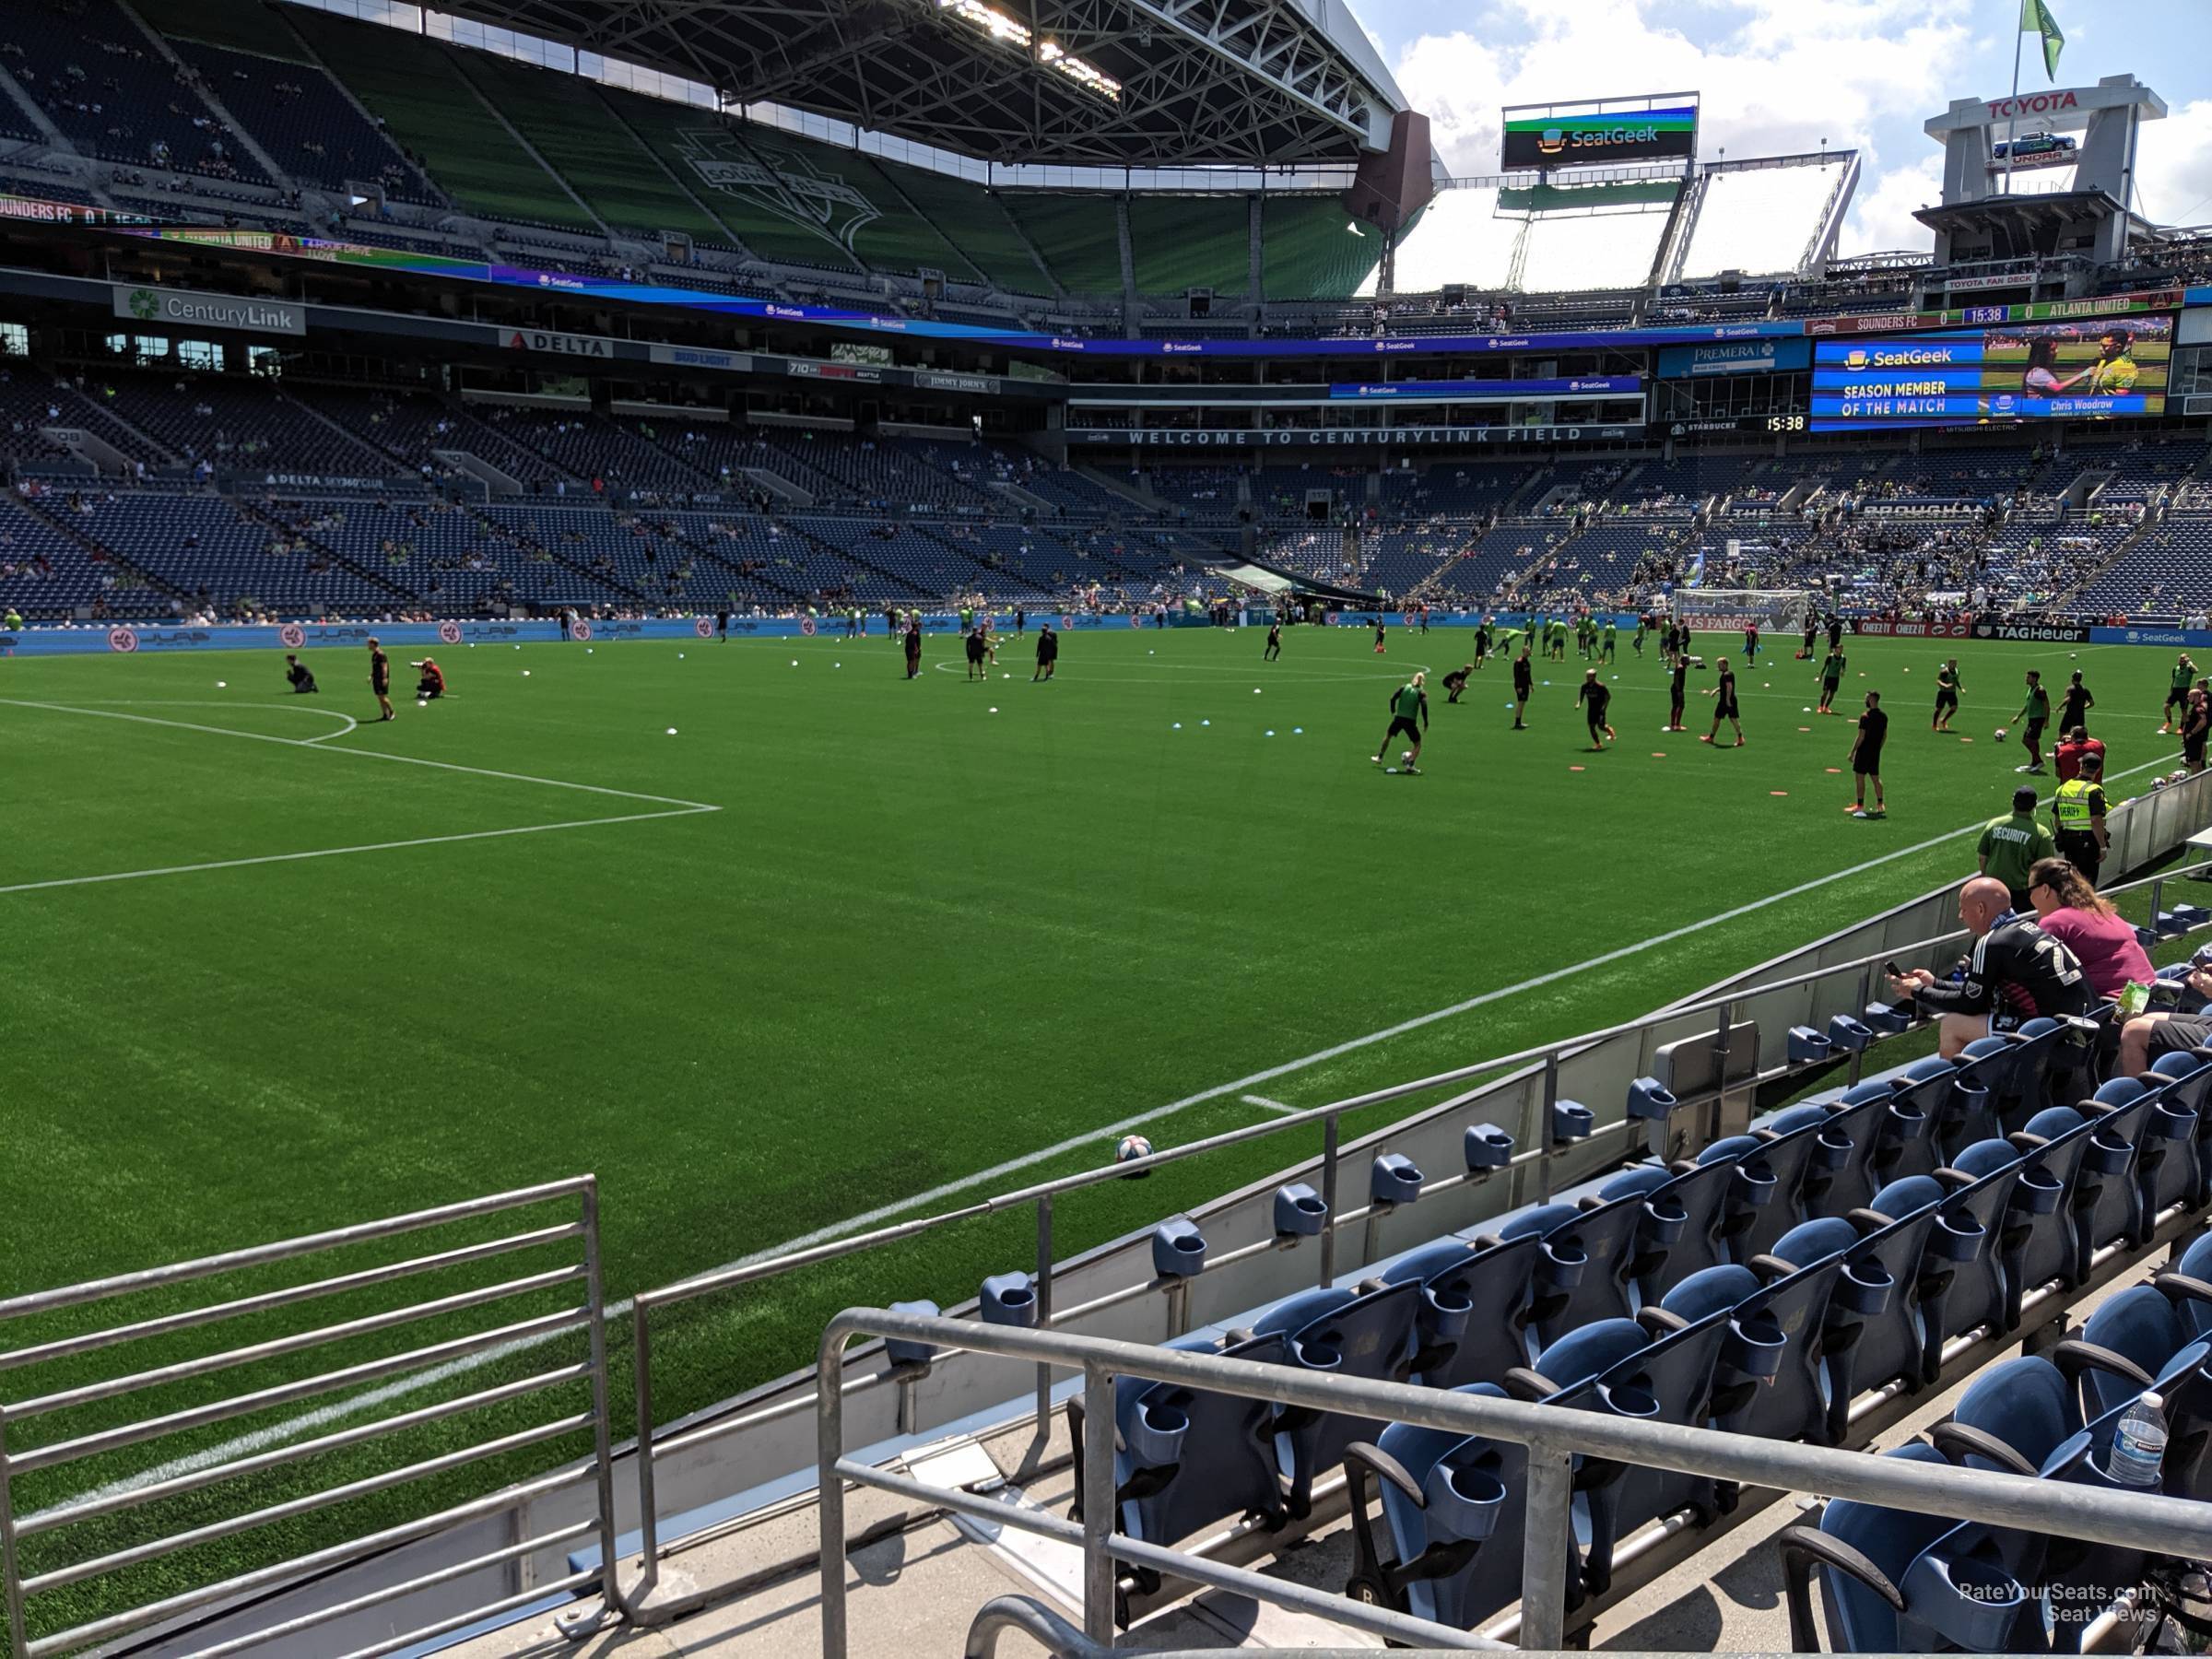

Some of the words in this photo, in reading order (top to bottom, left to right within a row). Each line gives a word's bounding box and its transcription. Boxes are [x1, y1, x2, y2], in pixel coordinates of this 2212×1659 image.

[1988, 91, 2077, 118] TOYOTA
[1571, 126, 1658, 147] SeatGeek
[2005, 152, 2062, 164] UNDRA
[57, 208, 72, 223] FC
[235, 235, 271, 250] UNITED
[1950, 279, 1983, 288] TOYOTA
[1987, 277, 2004, 286] FAN
[2007, 276, 2031, 284] DECK
[168, 298, 293, 328] CenturyLink
[1858, 316, 1904, 330] SOUNDERS
[1906, 315, 1917, 327] FC
[1940, 312, 1947, 324] 0
[1972, 308, 2001, 323] 15:38
[2025, 306, 2033, 318] 0
[2050, 301, 2092, 316] ATLANTA
[2095, 299, 2130, 312] UNITED
[1726, 327, 1758, 336] SeatGeek
[535, 335, 604, 355] DELTA
[1386, 342, 1415, 350] SeatGeek
[1499, 338, 1529, 347] SeatGeek
[1695, 347, 1755, 361] PREMERA
[1874, 347, 1951, 366] SeatGeek
[790, 363, 808, 373] 710
[930, 376, 958, 386] JIMMY
[1581, 381, 1610, 390] SeatGeek
[1844, 383, 1891, 399] SEASON
[1895, 381, 1946, 396] MEMBER
[1842, 403, 1859, 416] OF
[1866, 401, 1890, 415] THE
[1897, 398, 1945, 413] MATCH
[2051, 400, 2072, 411] Chris
[2075, 399, 2113, 410] Woodrow
[1688, 422, 1735, 430] STARBUCKS
[1768, 417, 1804, 431] 15:38
[1129, 432, 1245, 444] WELCOME
[1264, 431, 1290, 444] TO
[1309, 429, 1488, 444] CENTURYLINK
[1507, 428, 1581, 441] FIELD
[279, 475, 321, 485] DELTA
[1733, 509, 1771, 519] THE
[1708, 618, 1751, 629] FARGO
[1996, 627, 2029, 639] TAG
[2031, 628, 2083, 641] Heuer
[2142, 633, 2185, 642] SeatGeek
[1993, 827, 2031, 845] SECURITY
